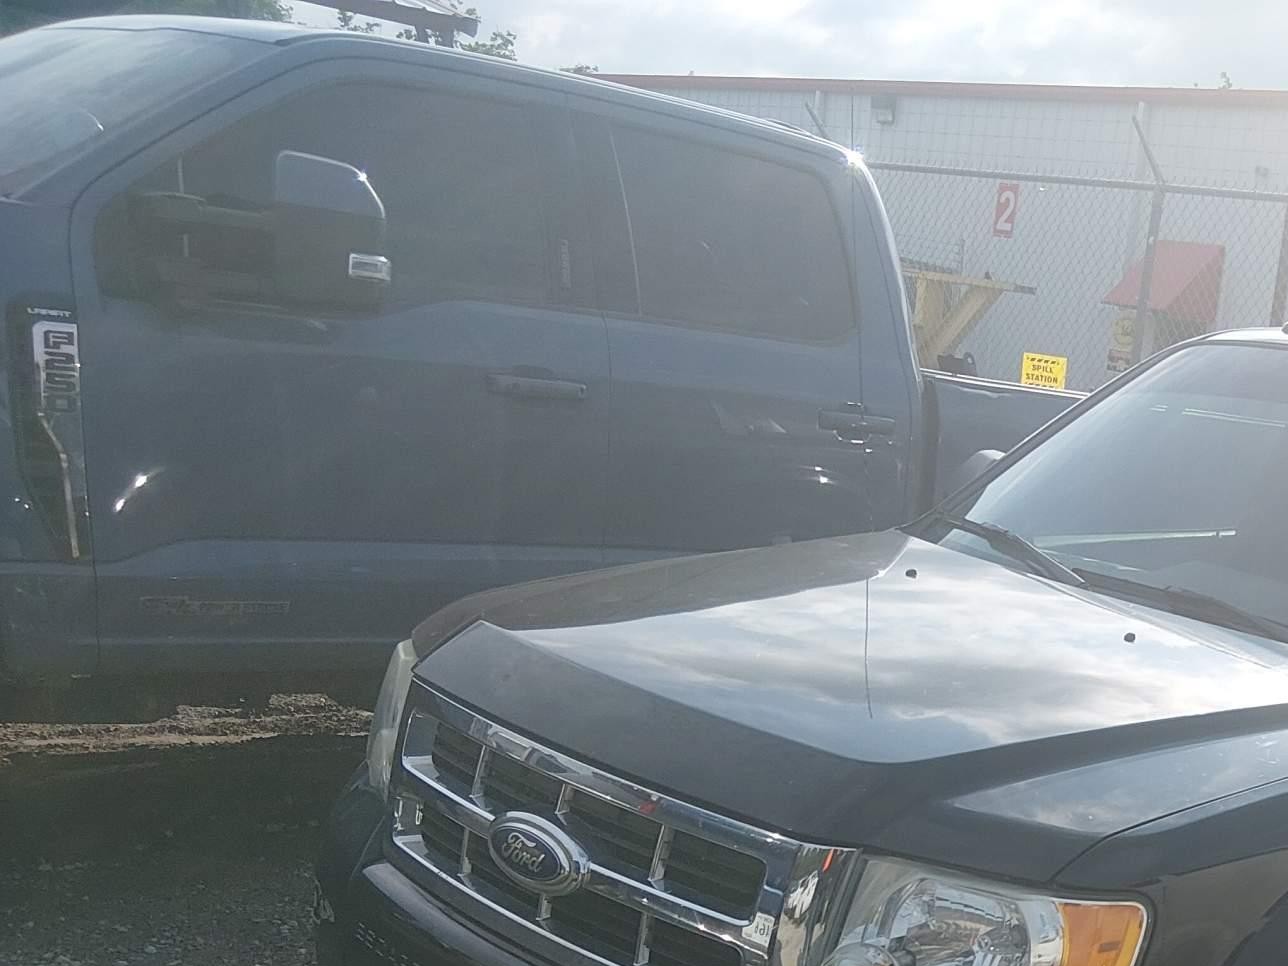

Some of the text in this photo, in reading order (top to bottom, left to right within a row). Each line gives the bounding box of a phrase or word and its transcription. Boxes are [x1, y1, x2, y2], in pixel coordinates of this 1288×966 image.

[996, 190, 1016, 231] 2
[1025, 372, 1059, 385] STATION
[1031, 364, 1053, 374] SPILL
[501, 831, 547, 873] Ford
